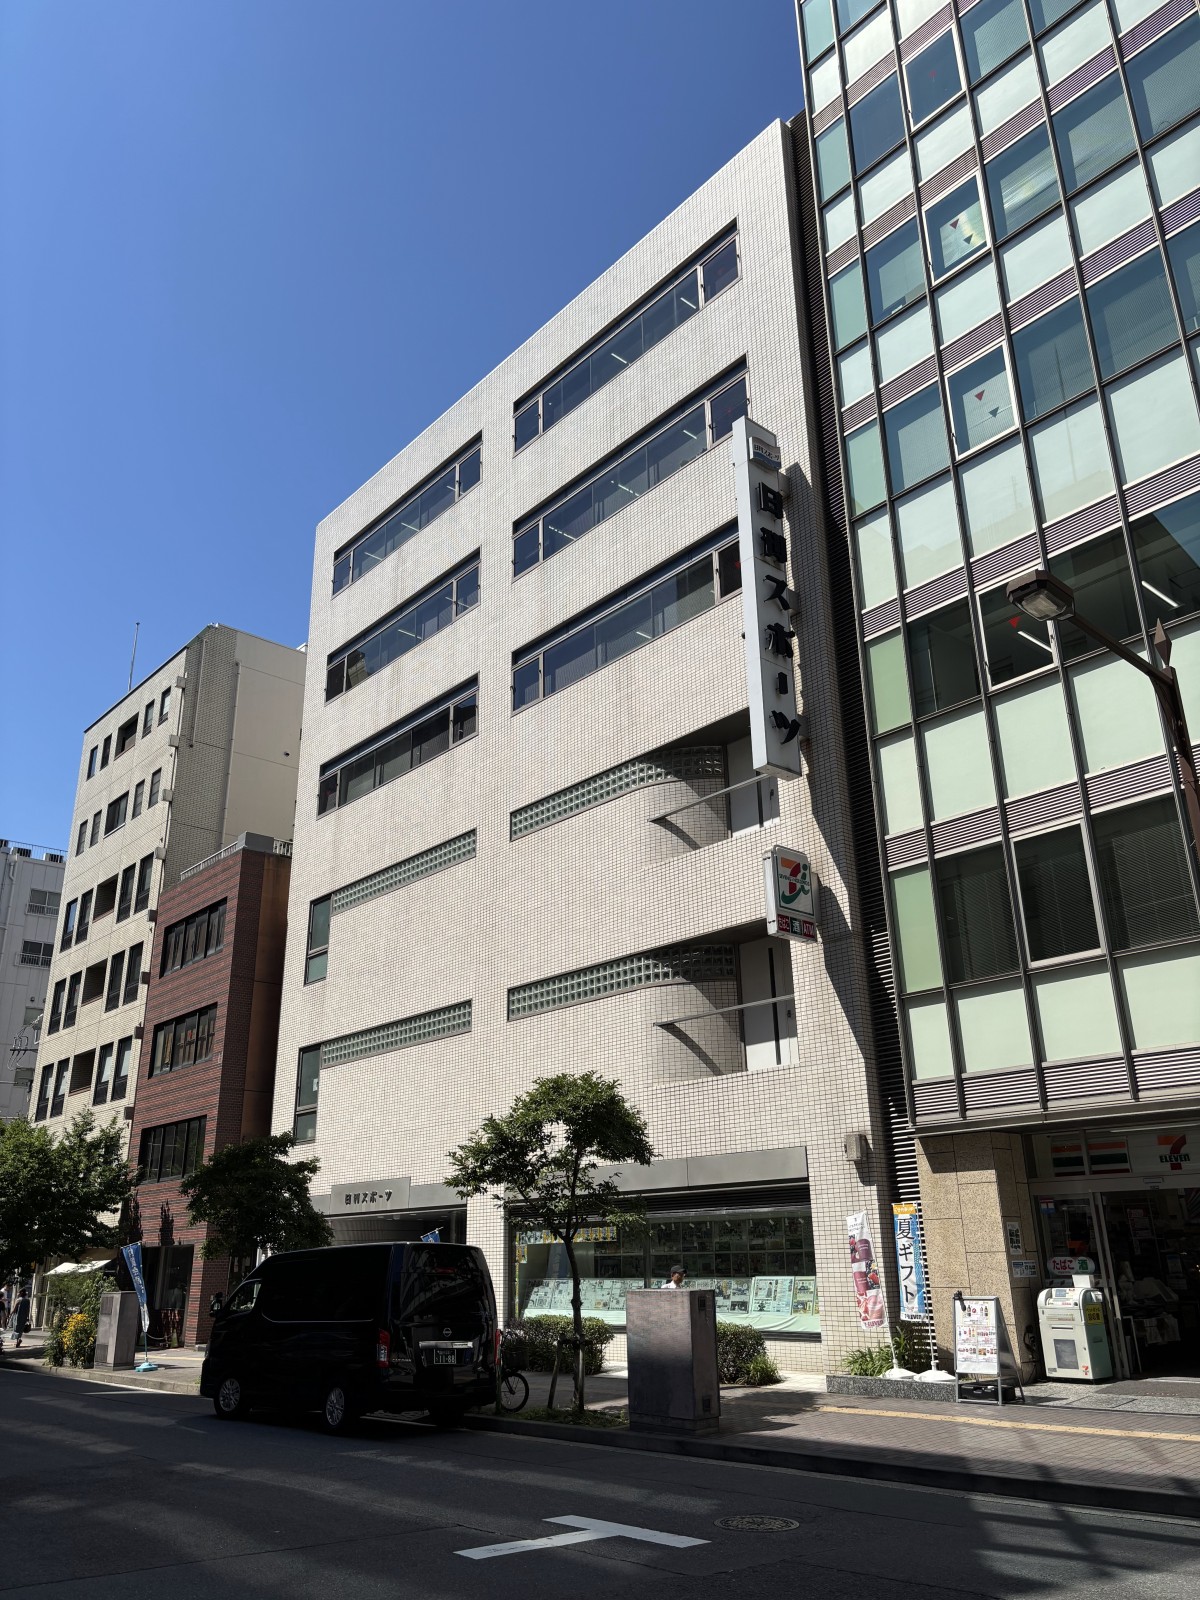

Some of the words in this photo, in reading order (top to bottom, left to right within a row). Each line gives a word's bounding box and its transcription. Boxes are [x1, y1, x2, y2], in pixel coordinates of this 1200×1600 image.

[345, 1190, 393, 1205] 日刊スポーツ
[896, 1216, 915, 1304] 夏ギフト
[1052, 1259, 1074, 1271] たばこ
[1077, 1259, 1089, 1271] 酒
